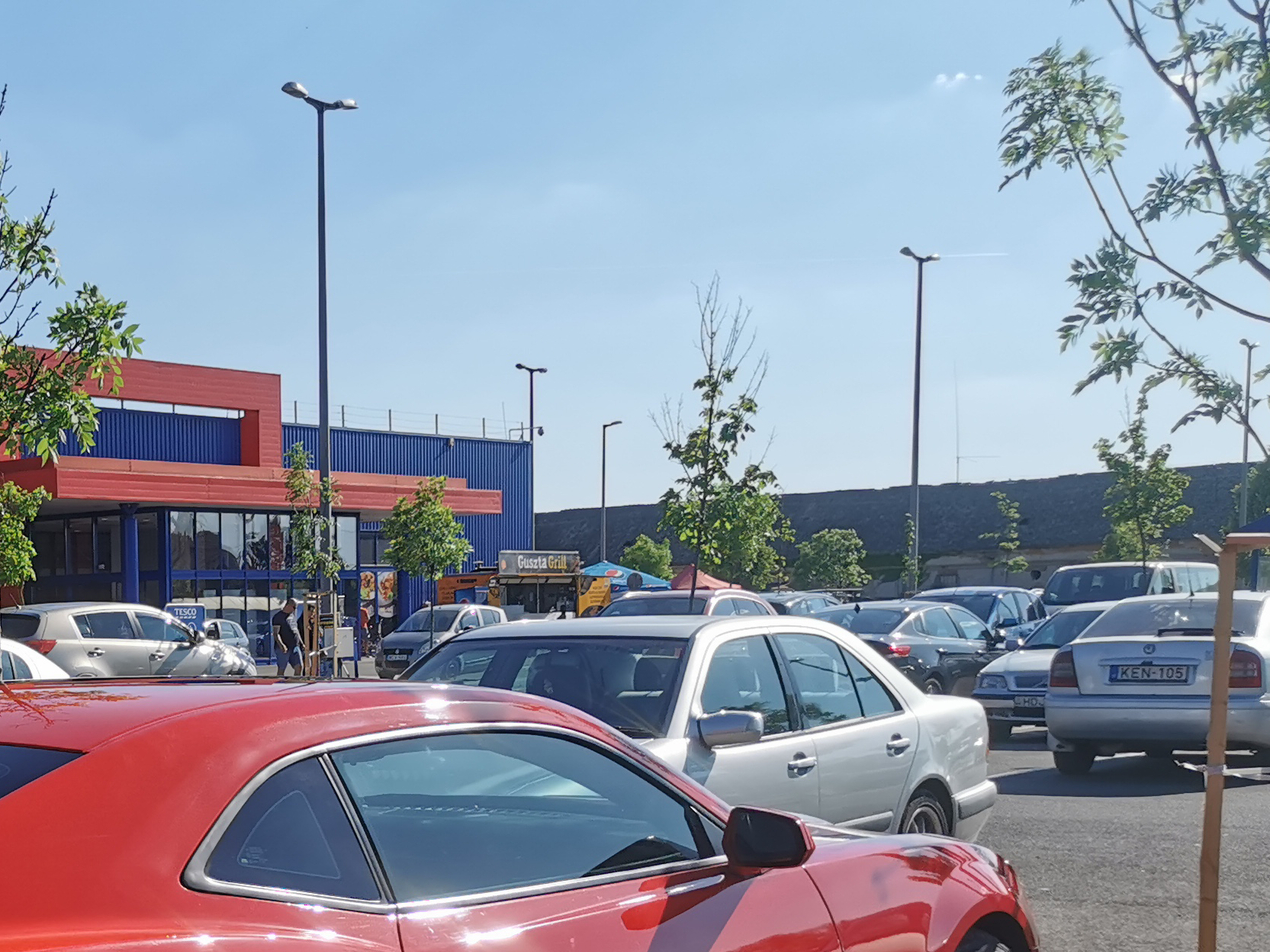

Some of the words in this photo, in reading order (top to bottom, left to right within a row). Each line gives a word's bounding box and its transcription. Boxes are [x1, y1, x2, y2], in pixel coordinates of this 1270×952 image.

[518, 555, 548, 569] Guszta
[548, 555, 567, 569] Grill
[174, 608, 197, 616] TESCO
[1120, 667, 1184, 679] KEN-105
